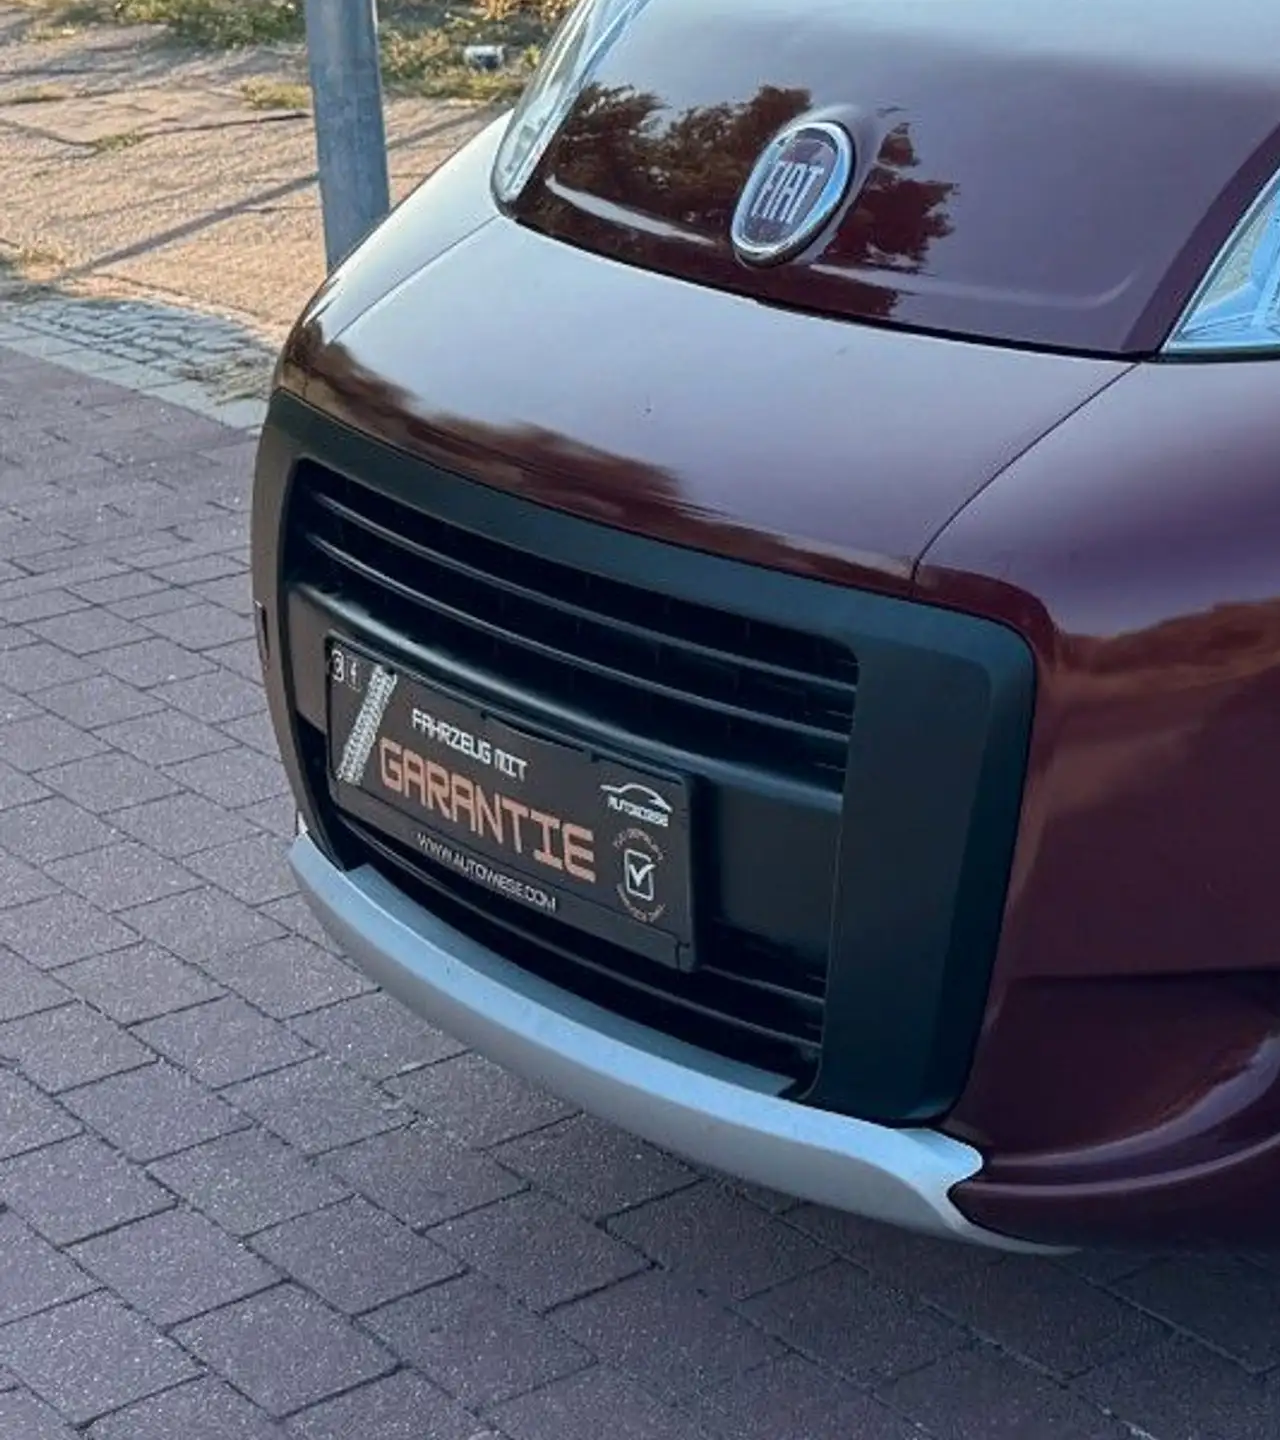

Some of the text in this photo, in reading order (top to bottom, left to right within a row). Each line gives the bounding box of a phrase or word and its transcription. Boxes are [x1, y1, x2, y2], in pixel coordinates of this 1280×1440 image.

[752, 160, 825, 225] FIAT
[411, 707, 528, 782] FAHRZEUG MIT
[379, 736, 596, 884] GARANTIE
